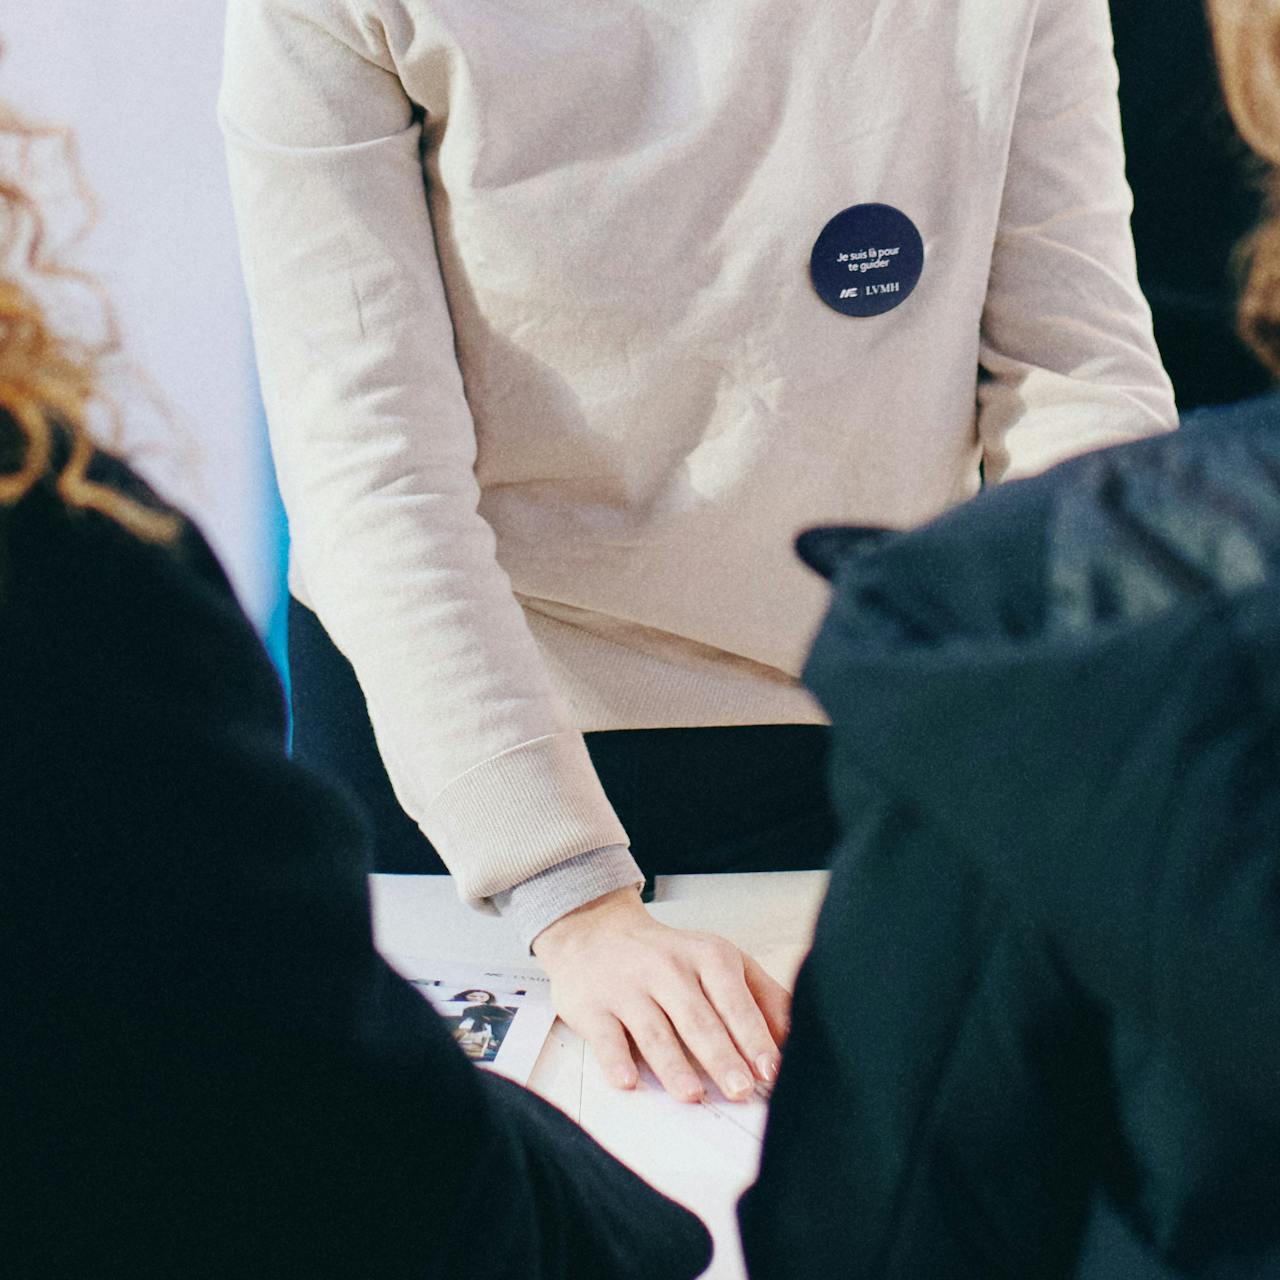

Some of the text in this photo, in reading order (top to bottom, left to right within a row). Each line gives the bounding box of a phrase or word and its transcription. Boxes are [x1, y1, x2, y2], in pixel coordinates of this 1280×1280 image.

[836, 251, 849, 263] Je
[849, 249, 868, 260] suis
[877, 246, 901, 261] pour
[847, 258, 891, 273] te guider
[865, 282, 901, 296] LVMH
